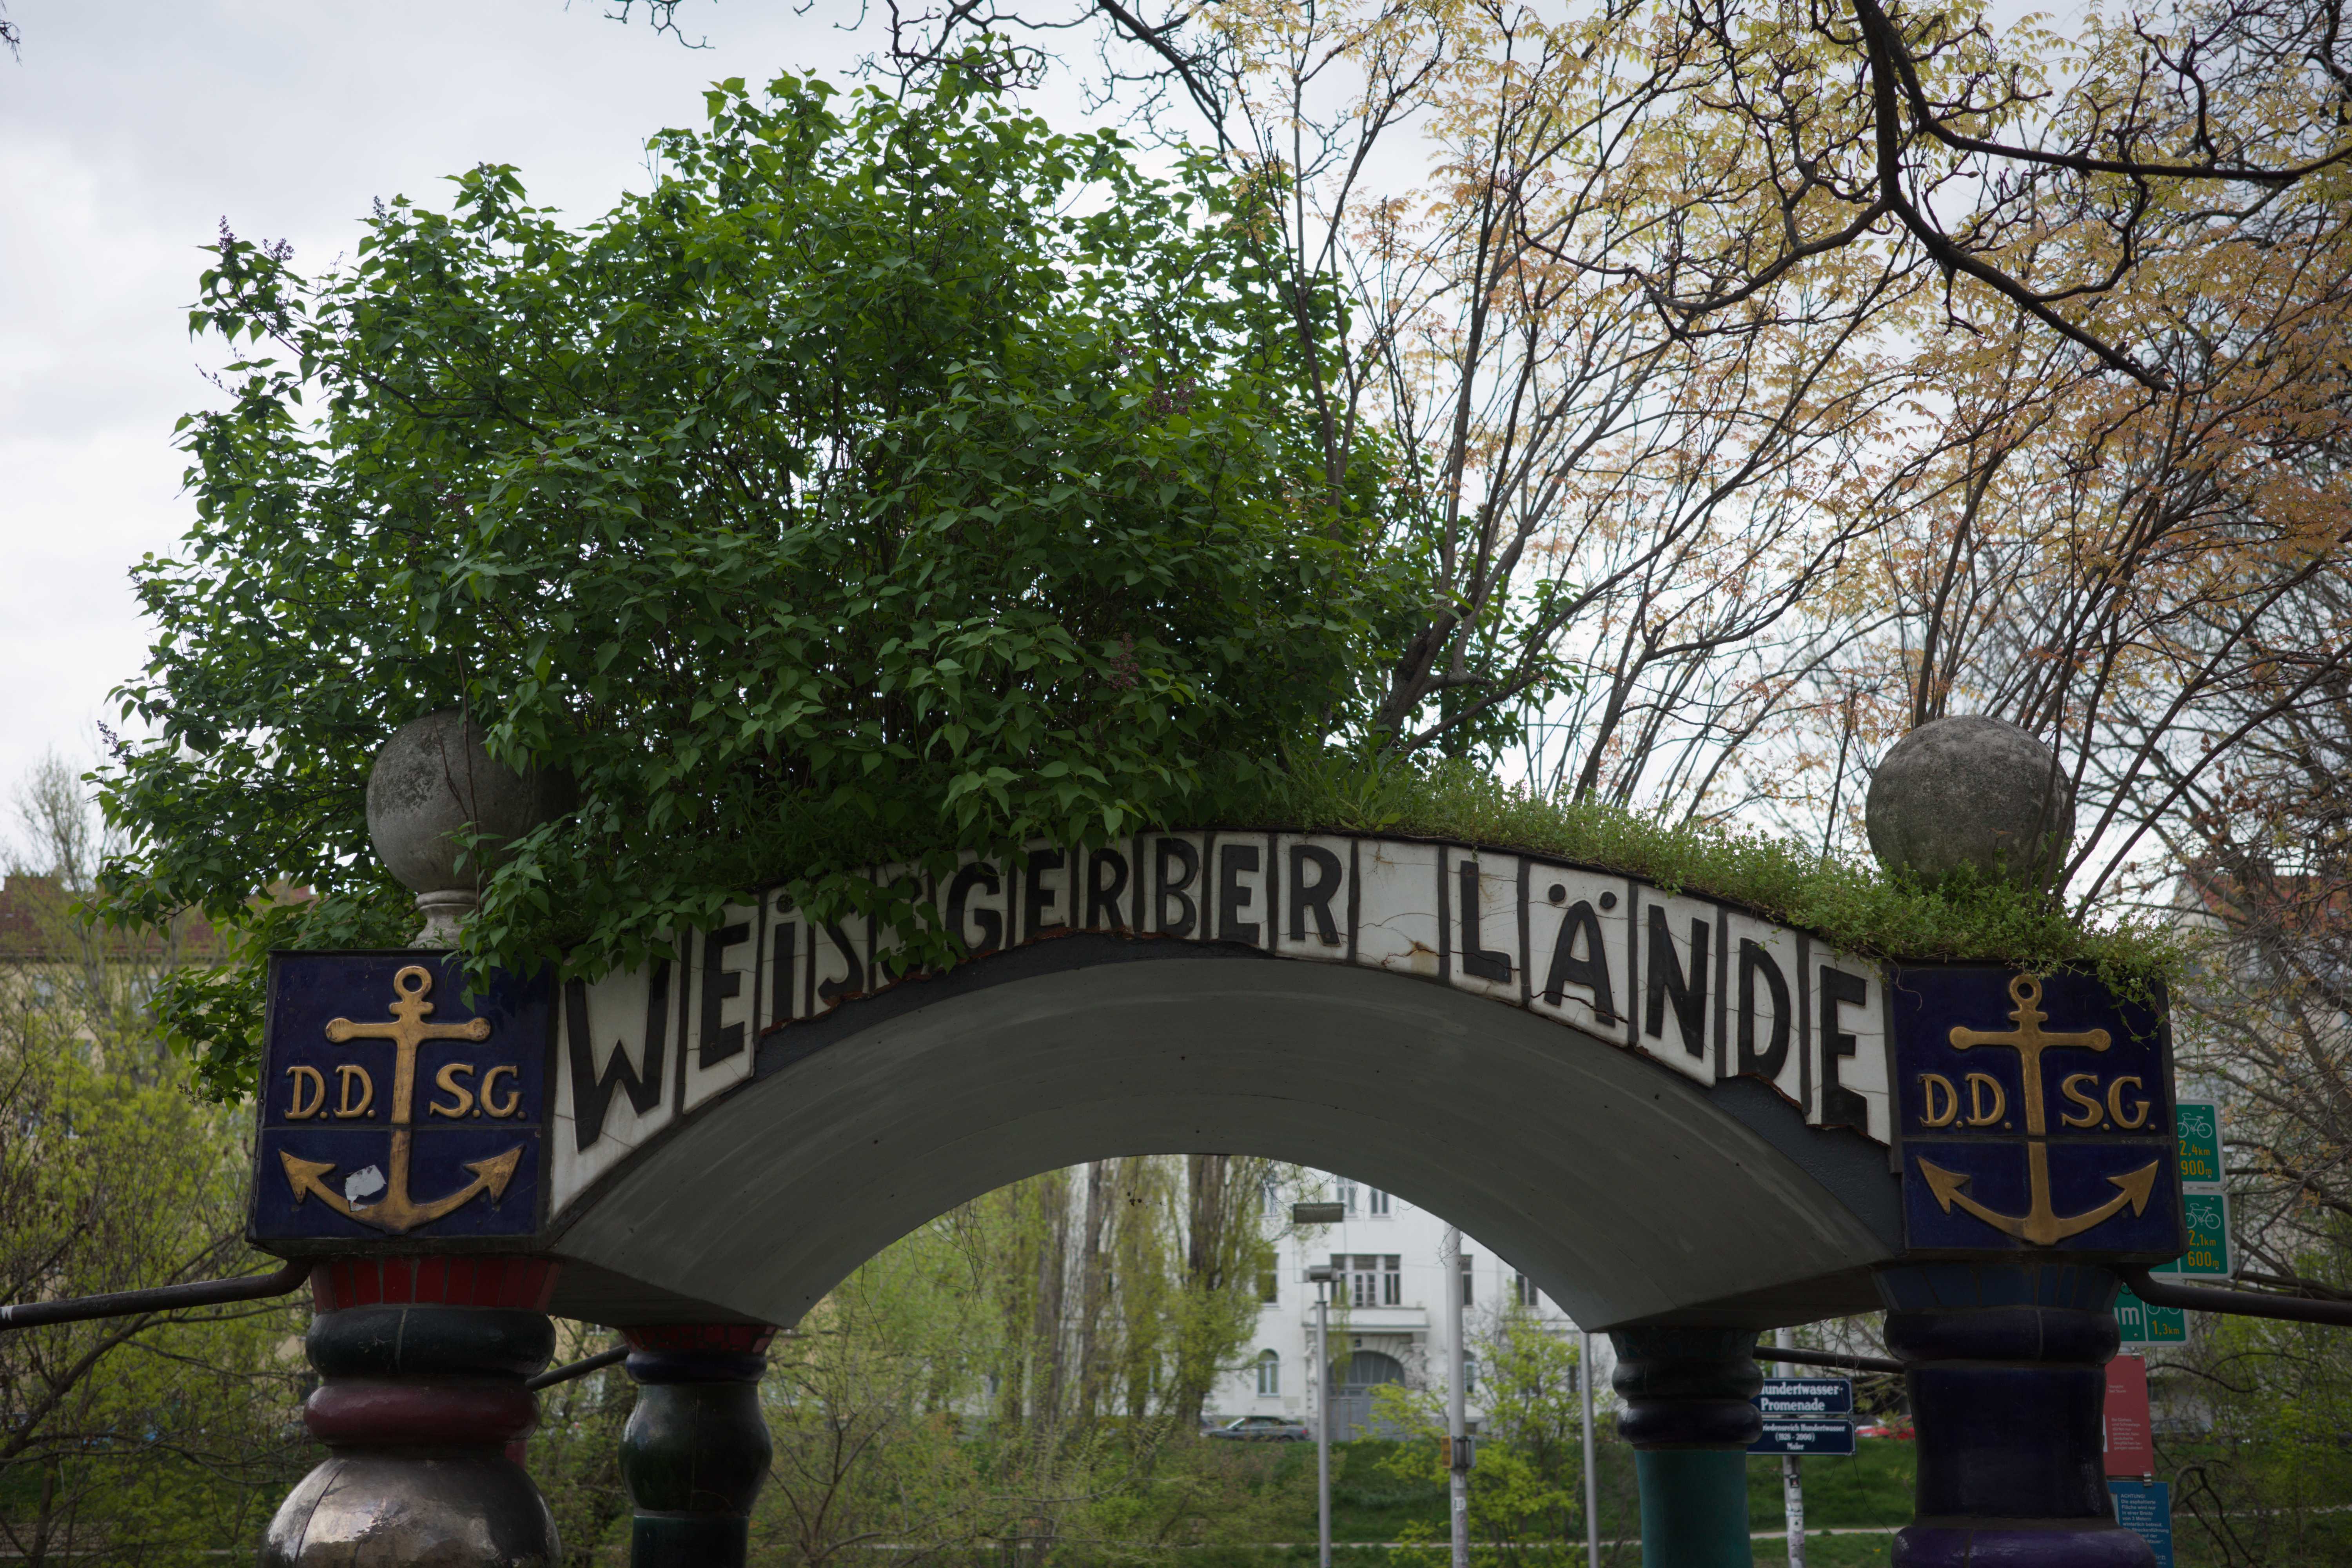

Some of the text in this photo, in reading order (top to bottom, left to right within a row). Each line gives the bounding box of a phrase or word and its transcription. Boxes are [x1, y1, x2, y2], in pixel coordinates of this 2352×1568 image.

[1460, 860, 1868, 1129] LÄNDE
[1760, 1397, 1826, 1411] Promenade
[1762, 1423, 1846, 1432] riedensreich Hundertwasser
